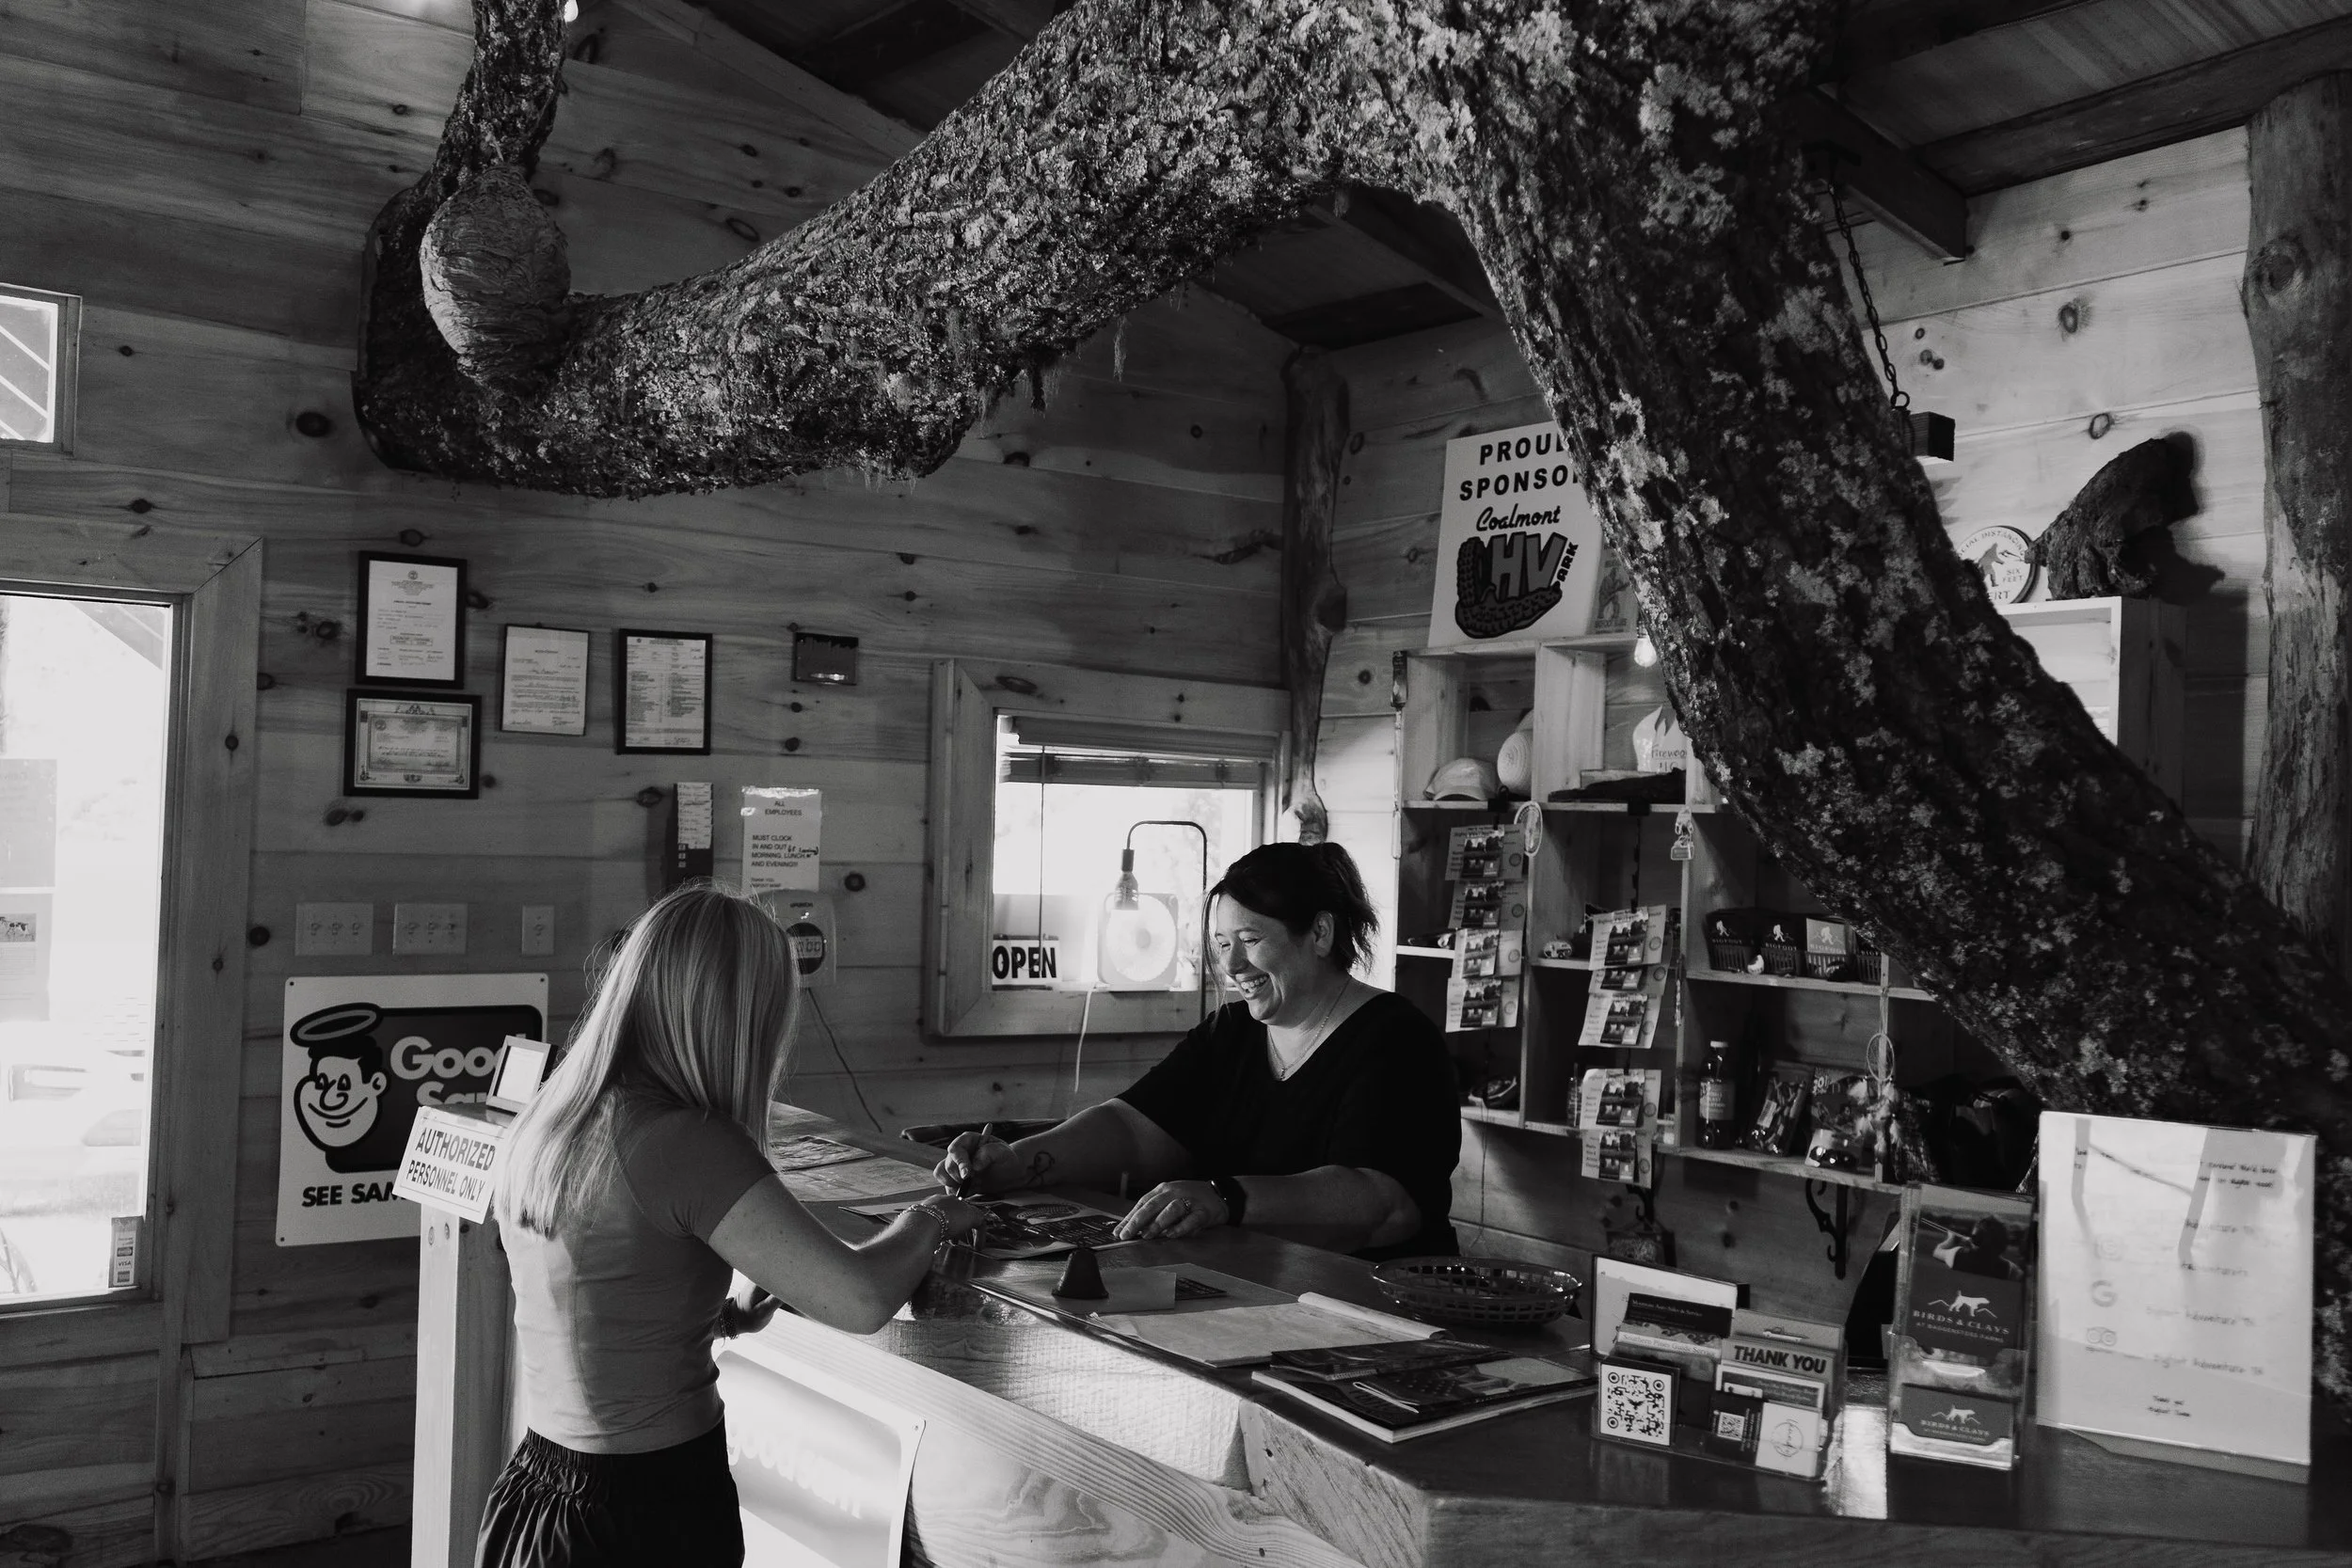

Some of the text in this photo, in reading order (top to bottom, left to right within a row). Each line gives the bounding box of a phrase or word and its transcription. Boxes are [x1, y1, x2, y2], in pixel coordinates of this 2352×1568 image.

[1459, 465, 1578, 500] SPONSO
[1475, 503, 1561, 531] Coalmont
[1651, 743, 1687, 758] Firewoo
[1765, 942, 1797, 951] BIGFOOT
[993, 945, 1057, 979] OPEN
[390, 1034, 526, 1080] Goo
[415, 1127, 496, 1171] AUTHORIZED
[406, 1160, 485, 1202] PERSONNEL ONLY
[302, 1185, 343, 1208] SEE
[1913, 1309, 1953, 1323] BIRDS
[1967, 1320, 2010, 1335] CLAYS
[1671, 1341, 1691, 1353] Guide
[1734, 1345, 1827, 1374] THANK YOU
[1920, 1419, 1951, 1429] BIRDS
[1959, 1427, 1990, 1436] CLAYS
